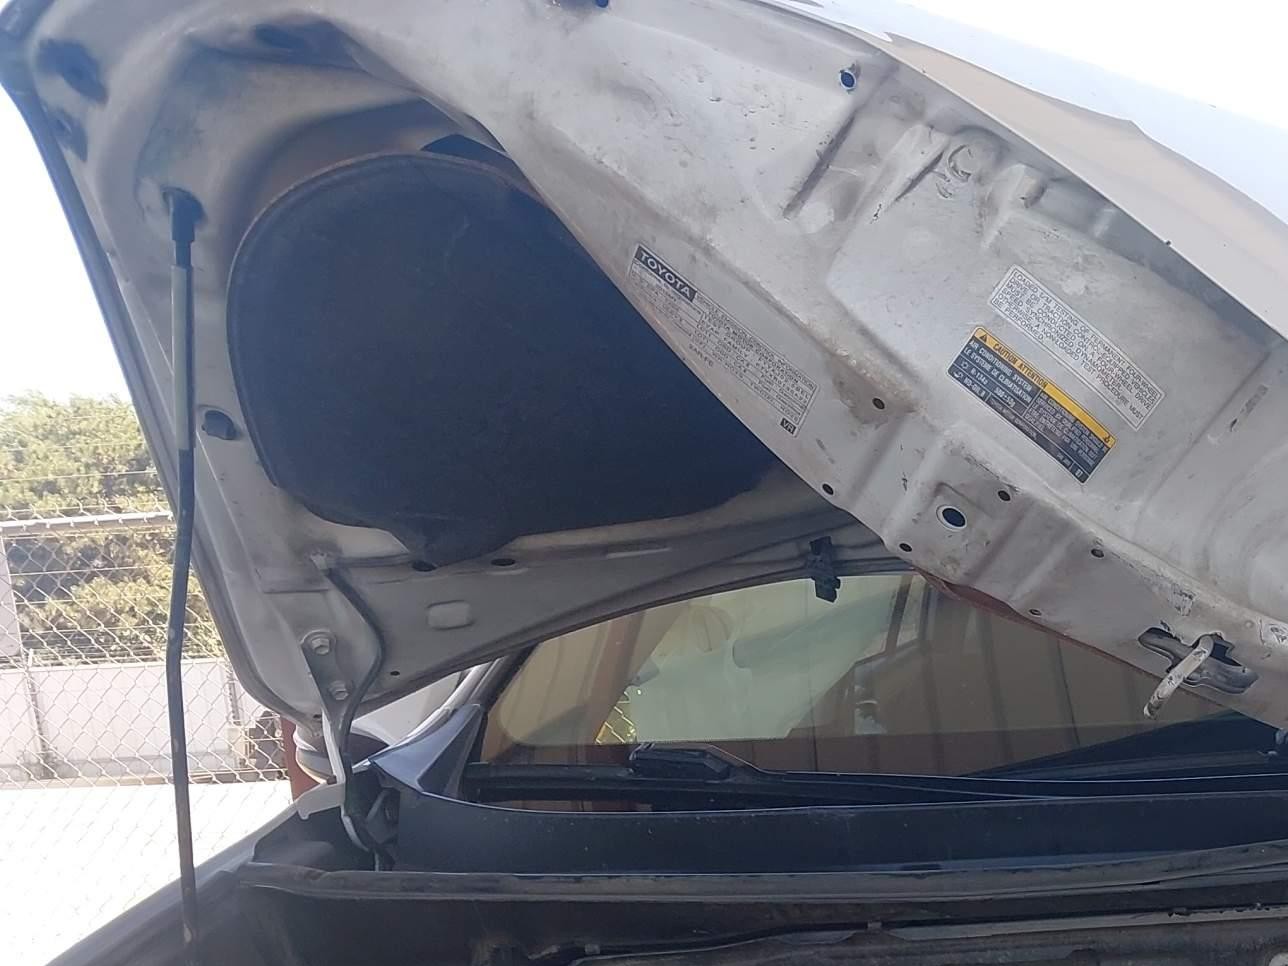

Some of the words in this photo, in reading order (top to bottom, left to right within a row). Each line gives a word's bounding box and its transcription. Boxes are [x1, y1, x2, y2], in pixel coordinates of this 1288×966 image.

[639, 252, 692, 298] TOYOTA
[992, 297, 1004, 309] BE
[1000, 286, 1024, 308] SPEED
[1023, 306, 1074, 348] SYNCHRONIZED
[1004, 280, 1025, 300] MUST
[1024, 297, 1035, 308] BE
[1036, 306, 1077, 342] CONDUCTED
[1076, 338, 1089, 352] ON
[1095, 355, 1135, 394] FOUR-WHEEL
[1133, 391, 1152, 410] DRIVE
[1008, 275, 1029, 295] DRIVE
[1028, 292, 1041, 304] OR
[1040, 301, 1072, 330] TRACTION
[1129, 378, 1156, 405] VEHICLES
[1012, 270, 1039, 294] LOADED
[1052, 302, 1079, 327] TESTING
[1078, 324, 1090, 335] OF
[1089, 333, 1126, 367] PERMANENT
[962, 346, 972, 356] LE
[989, 367, 999, 377] DE
[997, 372, 1033, 404] CLIMATISATION
[968, 338, 980, 350] AIR
[977, 345, 1013, 377] CONDITIONING
[1011, 372, 1033, 392] SYSTEM
[992, 341, 1018, 365] CAUTION
[1017, 361, 1048, 389] ATTENTION
[1079, 359, 1096, 375] TEST
[1095, 373, 1129, 407] PROCEDURE
[1128, 403, 1143, 420] MUST
[781, 419, 796, 434] VR
